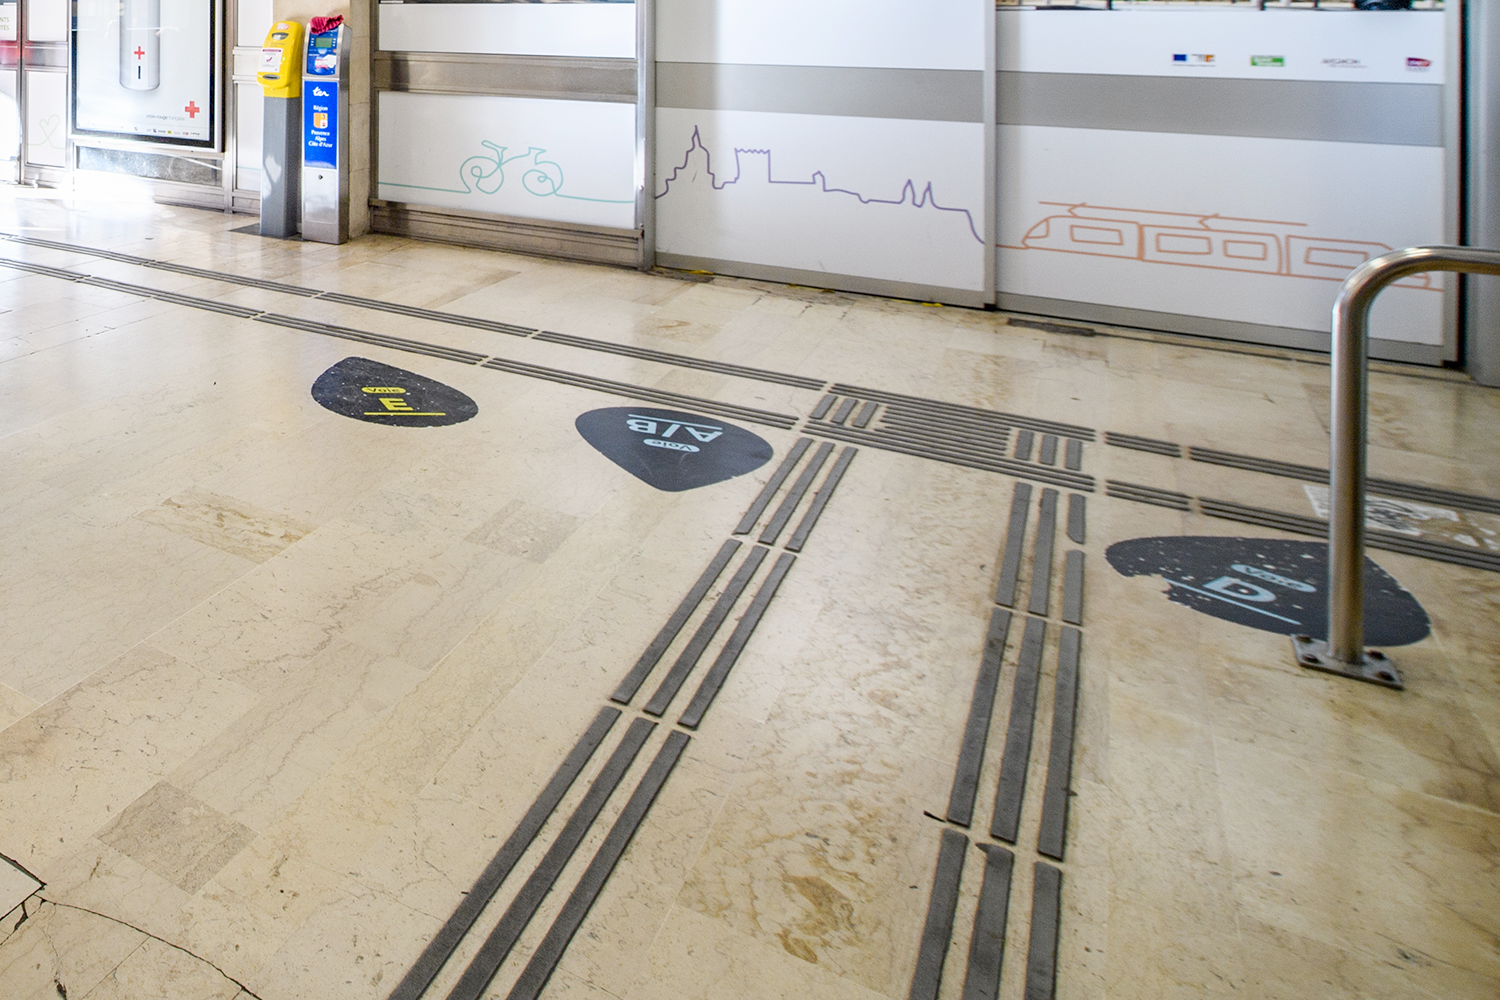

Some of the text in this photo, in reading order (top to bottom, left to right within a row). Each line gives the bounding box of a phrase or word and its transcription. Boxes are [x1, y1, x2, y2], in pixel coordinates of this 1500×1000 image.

[312, 86, 330, 97] ter
[313, 104, 328, 112] Région
[379, 397, 414, 411] E
[626, 419, 723, 442] A/B
[652, 440, 692, 451] Voie
[1203, 576, 1276, 602] D
